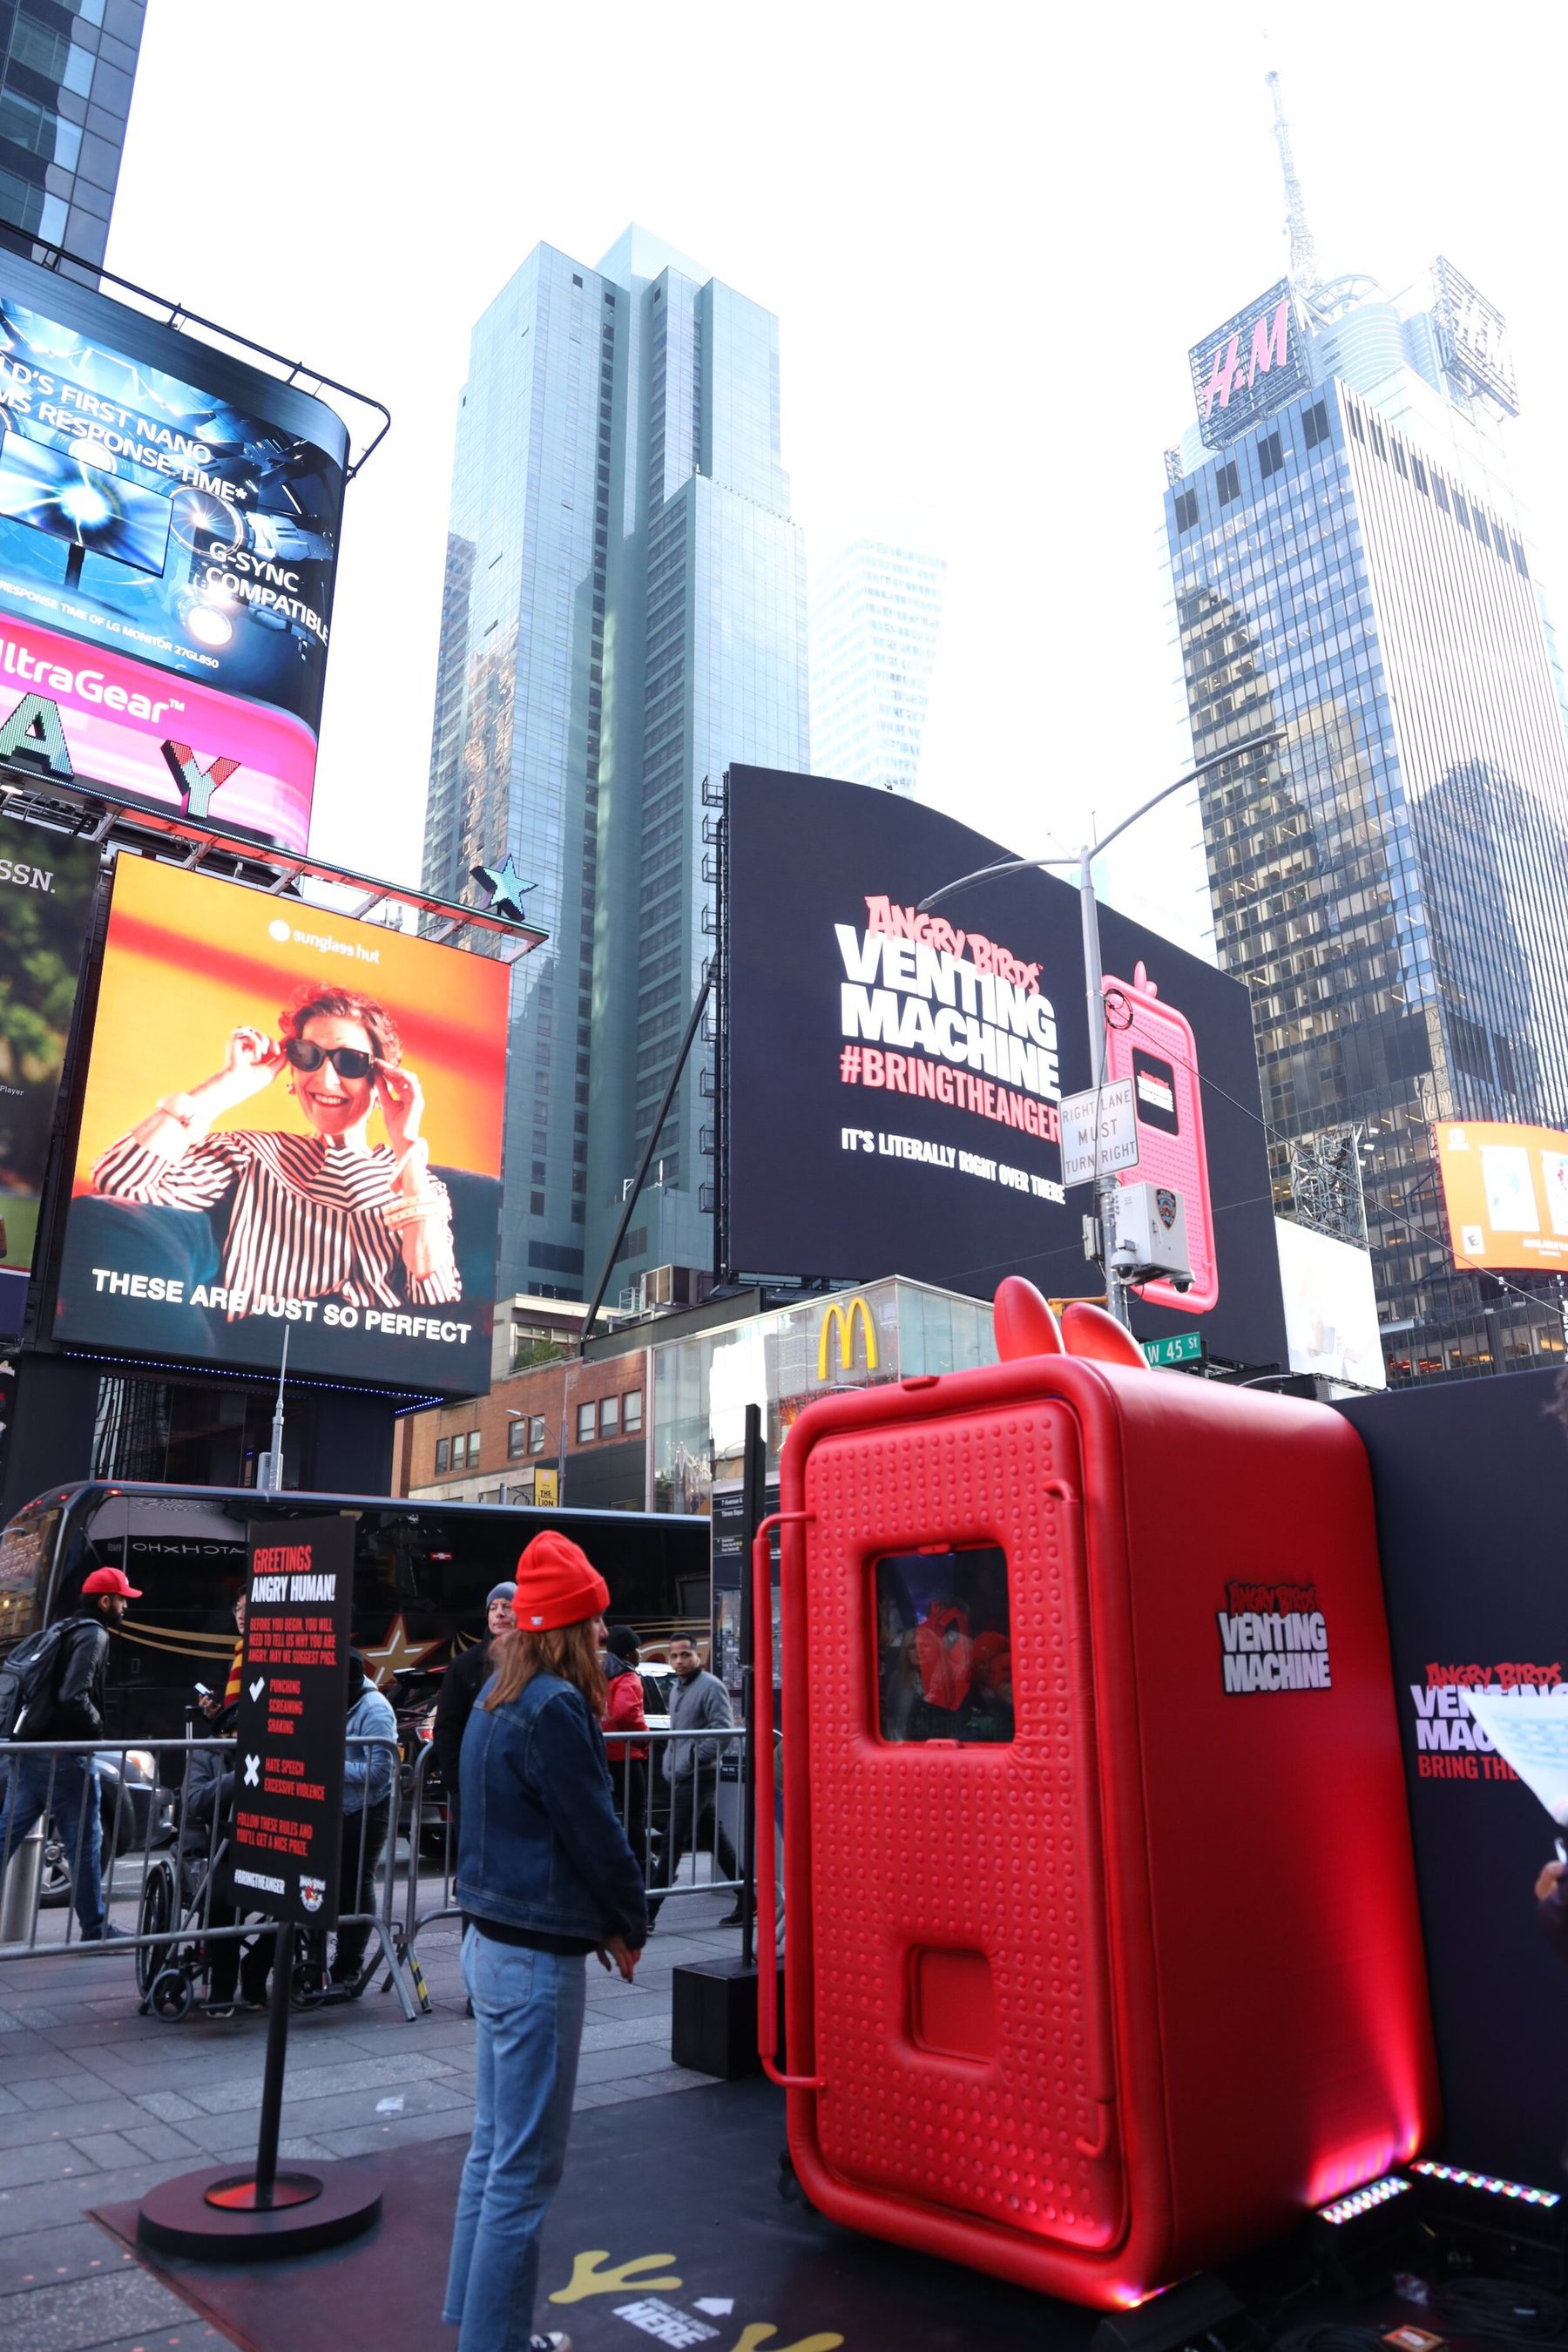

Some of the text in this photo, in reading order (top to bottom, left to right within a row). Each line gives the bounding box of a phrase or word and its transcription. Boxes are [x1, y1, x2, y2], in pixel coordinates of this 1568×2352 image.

[1200, 299, 1288, 419] H&M
[37, 402, 175, 475] RESPONSE
[61, 384, 132, 428] FIRST
[136, 417, 212, 464] NANO
[209, 542, 300, 592] G-SYNC
[206, 567, 329, 646] COMPATIBLE
[60, 602, 89, 621] TIME
[89, 614, 105, 626] OF
[105, 619, 120, 633] LG
[122, 625, 173, 652] MONITOR
[293, 929, 381, 963] sunglass hut
[864, 895, 965, 962] ANGRY
[835, 923, 1058, 1050] VENTING
[841, 982, 1061, 1102] MACHINE
[840, 1045, 1060, 1144] #BRINGTHEANGER
[1063, 1101, 1095, 1123] RIGHT
[1101, 1090, 1131, 1110] LANE
[1078, 1119, 1117, 1146] MUST
[841, 1127, 1066, 1205] IT'S LITERALLY RIGHT OVER THERE
[1065, 1141, 1135, 1173] TURN RIGHT
[91, 1268, 472, 1344] THESE ARE JUST SO PERFECT
[1147, 1335, 1198, 1364] W 45 St
[253, 1544, 312, 1573] GREETINGS
[251, 1574, 336, 1603] ANGRY HUMAN!
[250, 1617, 271, 1632] BEFORE
[272, 1617, 284, 1632] YOU
[305, 1618, 317, 1632] YOU
[1218, 1612, 1328, 1652] VENTING
[269, 1679, 301, 1694] PUNCHING
[1223, 1652, 1332, 1693] MACHINE
[1425, 1661, 1562, 1692] ANGRY BIRDS
[268, 1699, 303, 1715] SCREAMING
[265, 1757, 305, 1776] HATE SPEECH
[1418, 1755, 1479, 1779] BRING
[264, 1777, 295, 1795] EXCESSIVE
[237, 1812, 260, 1828] FOLLOW
[299, 1823, 313, 1840] AND
[612, 2301, 708, 2349] HERE
